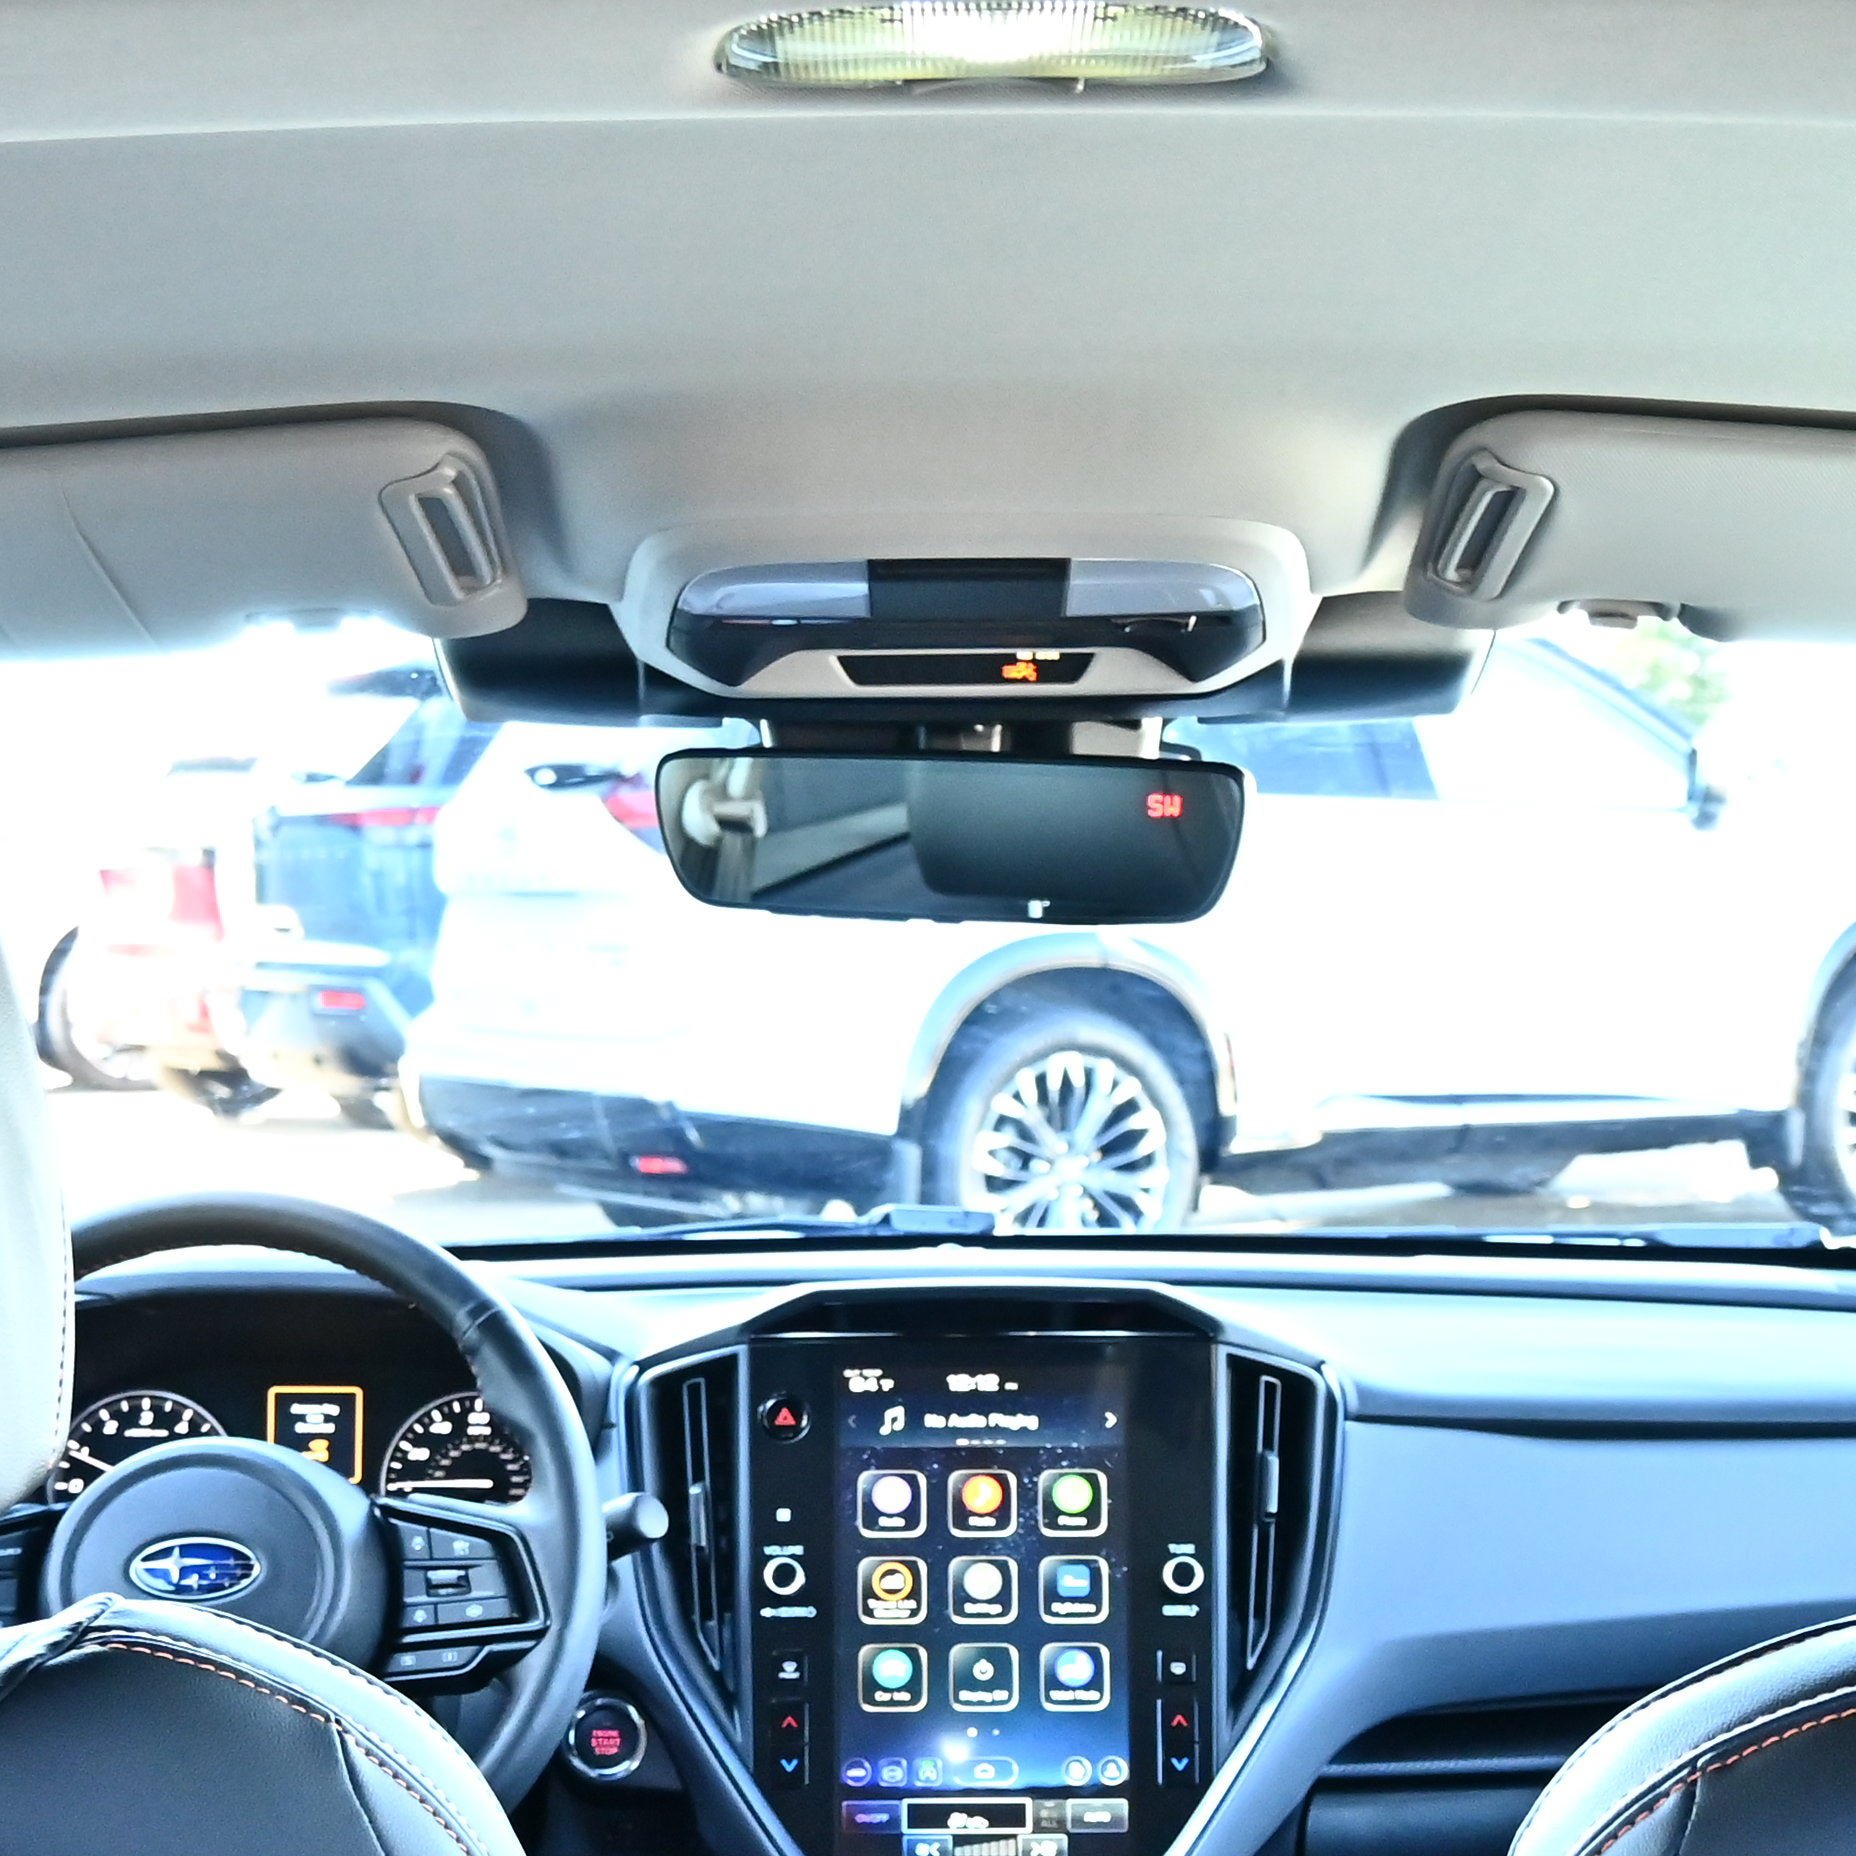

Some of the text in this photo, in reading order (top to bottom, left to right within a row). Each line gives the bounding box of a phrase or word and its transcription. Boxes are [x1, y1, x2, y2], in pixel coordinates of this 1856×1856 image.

[1147, 793, 1183, 818] SW
[591, 1737, 621, 1748] START
[594, 1747, 619, 1756] STOP
